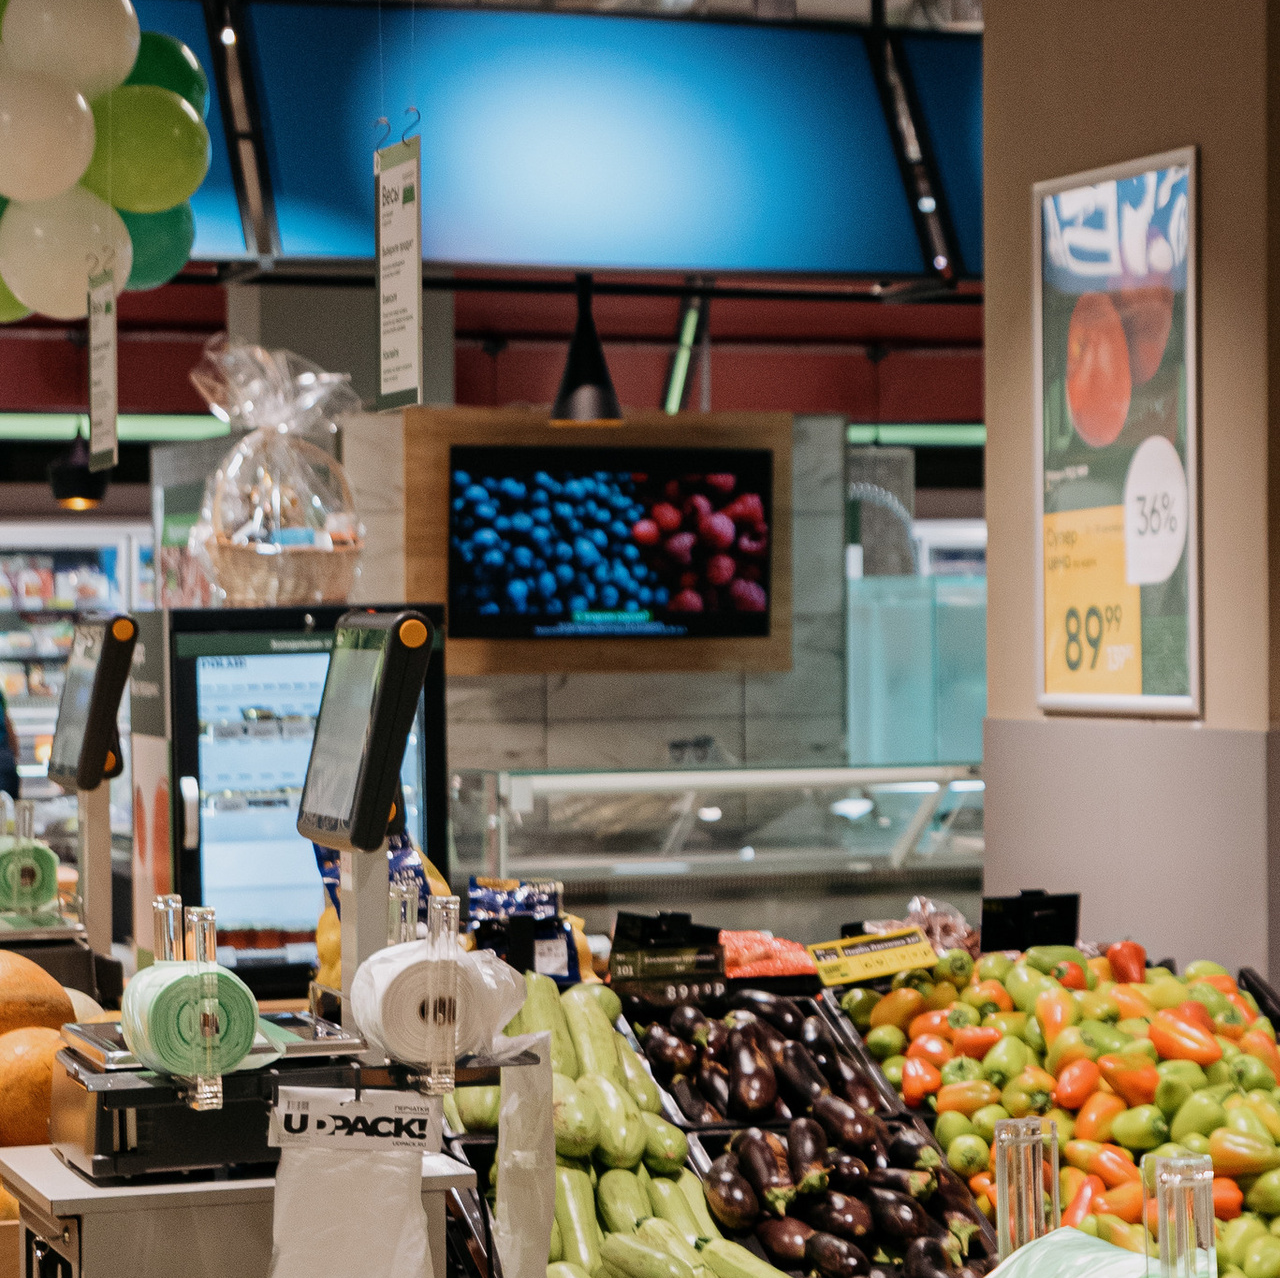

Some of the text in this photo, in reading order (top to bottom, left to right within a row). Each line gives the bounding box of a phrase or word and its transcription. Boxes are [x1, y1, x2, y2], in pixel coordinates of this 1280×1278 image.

[1136, 492, 1177, 536] 36%
[1065, 605, 1104, 671] 89
[616, 965, 634, 976] 101
[394, 1105, 430, 1113] ПЕРЧАТКИ
